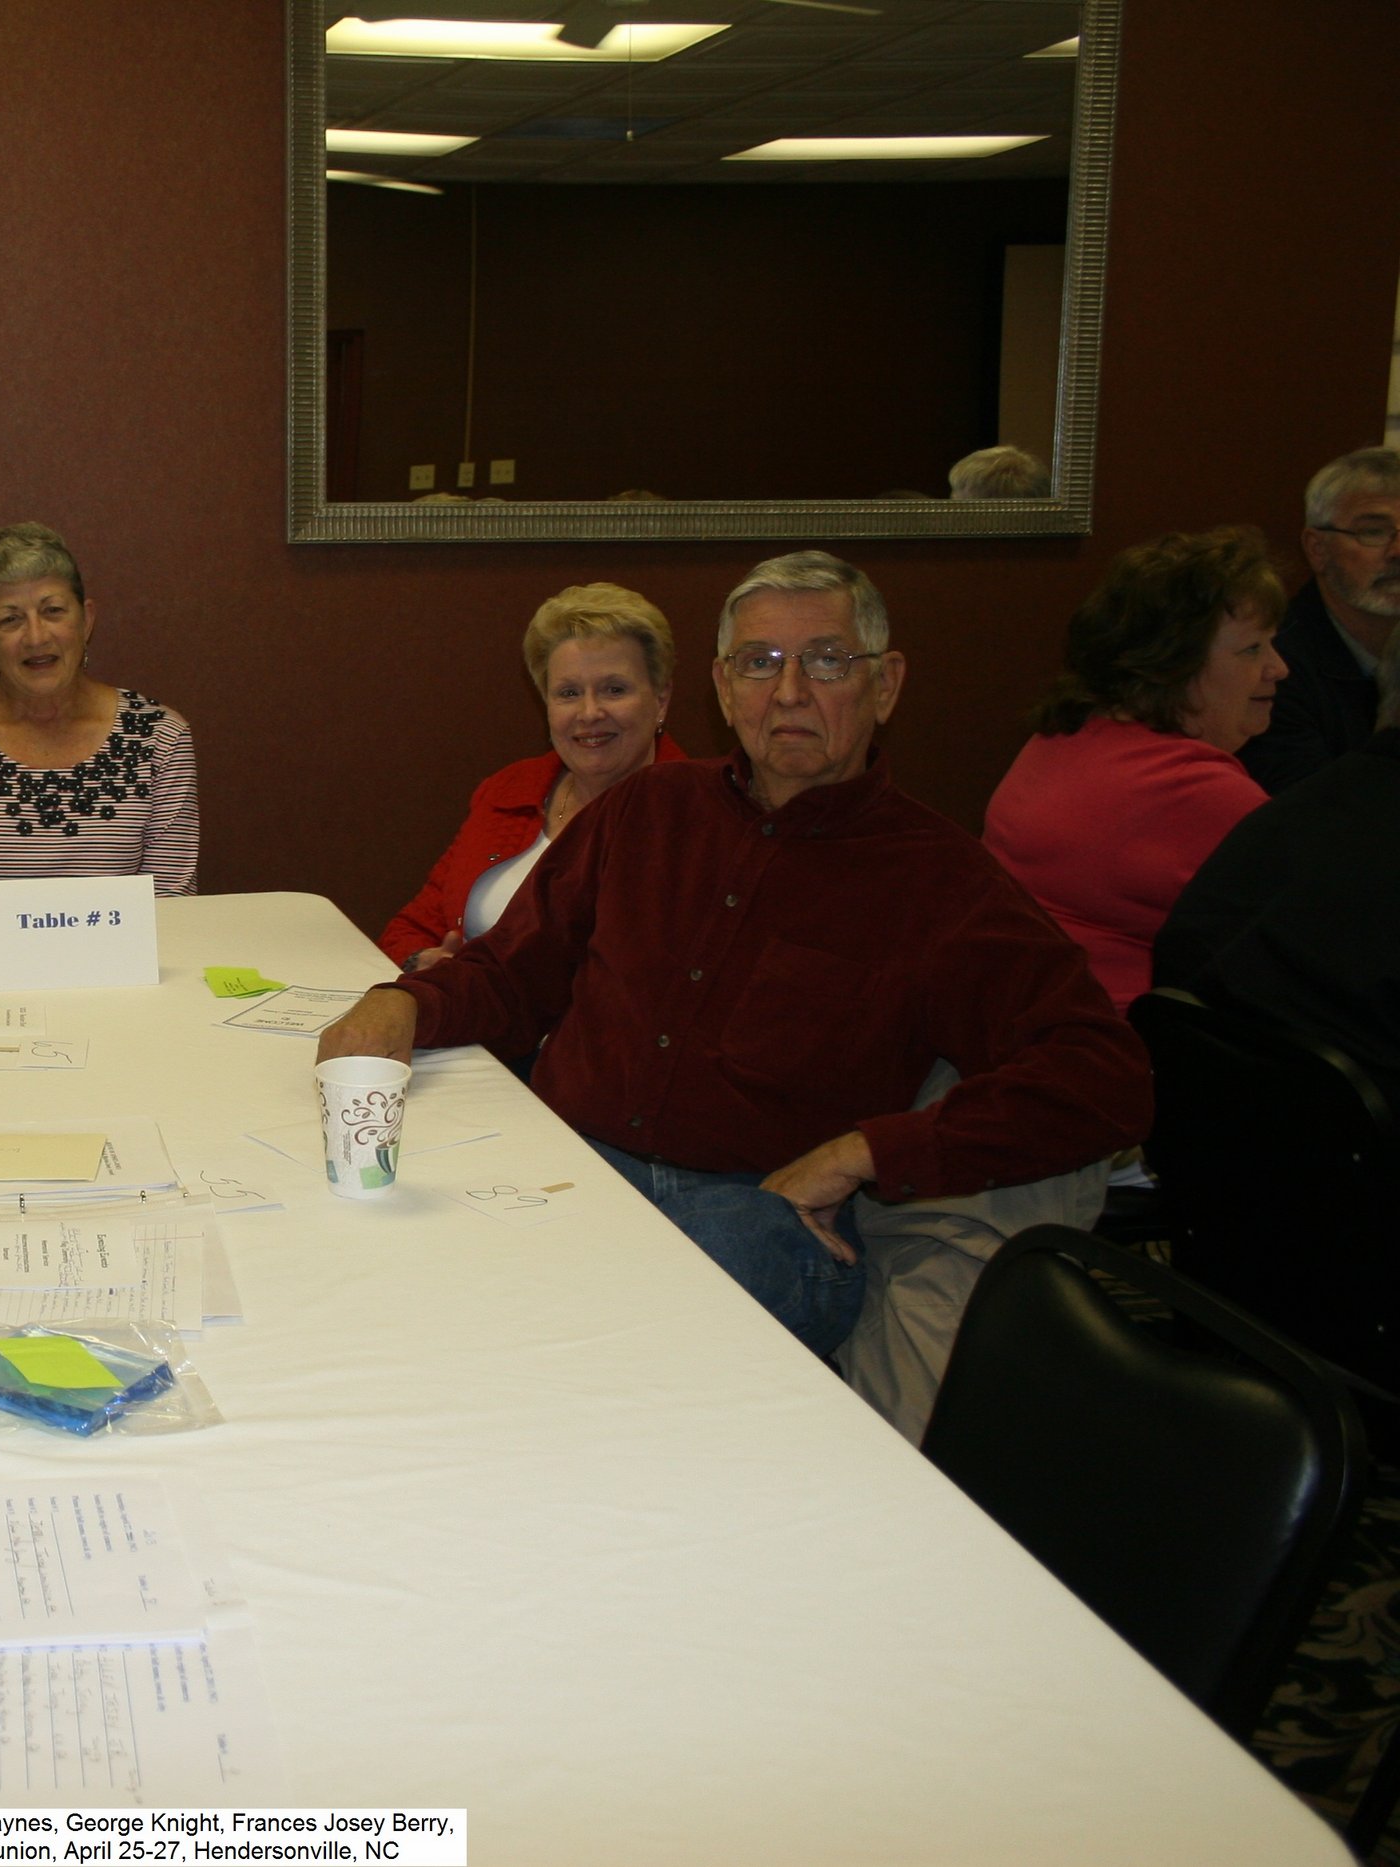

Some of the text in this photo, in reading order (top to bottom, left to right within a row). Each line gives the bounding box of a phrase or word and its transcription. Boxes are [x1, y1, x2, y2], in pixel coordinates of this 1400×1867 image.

[16, 910, 121, 929] Table # 3
